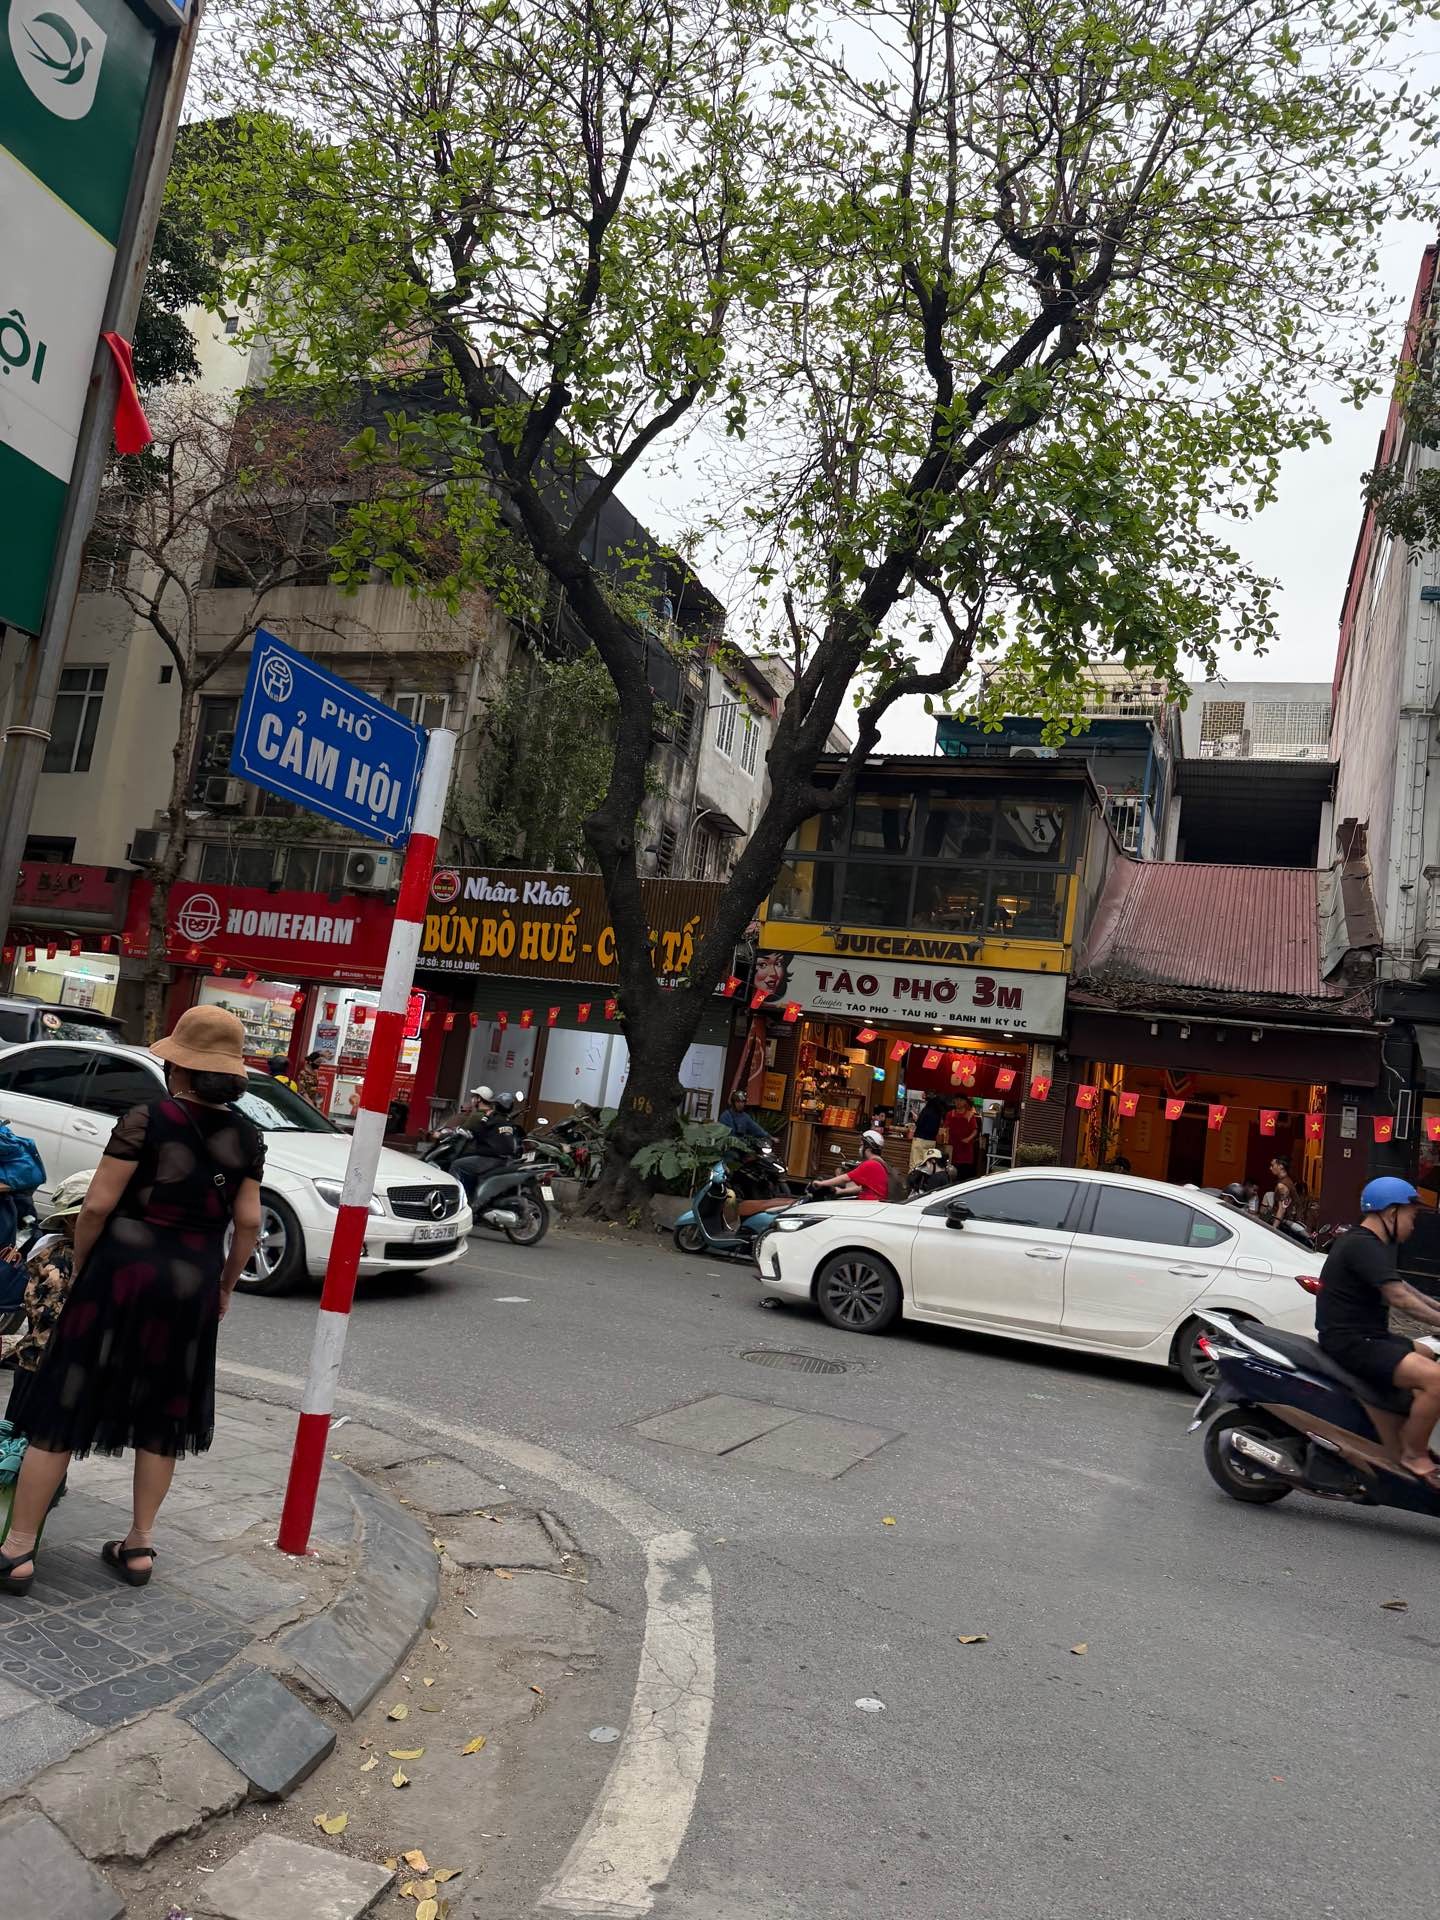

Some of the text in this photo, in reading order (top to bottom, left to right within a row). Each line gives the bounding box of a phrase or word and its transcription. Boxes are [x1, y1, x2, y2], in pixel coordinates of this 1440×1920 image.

[320, 698, 376, 742] PHỐ
[257, 710, 401, 822] CẢM HỘI
[463, 877, 519, 903] Nhân
[226, 908, 354, 945] HOMEFARM
[423, 906, 478, 954] BÚN
[480, 909, 516, 958] BÒ
[520, 907, 580, 963] HUẾ
[662, 915, 704, 972] TẤ
[835, 934, 979, 962] JUICEAWAY
[815, 969, 1024, 1010] TÀO PHỚ 3M
